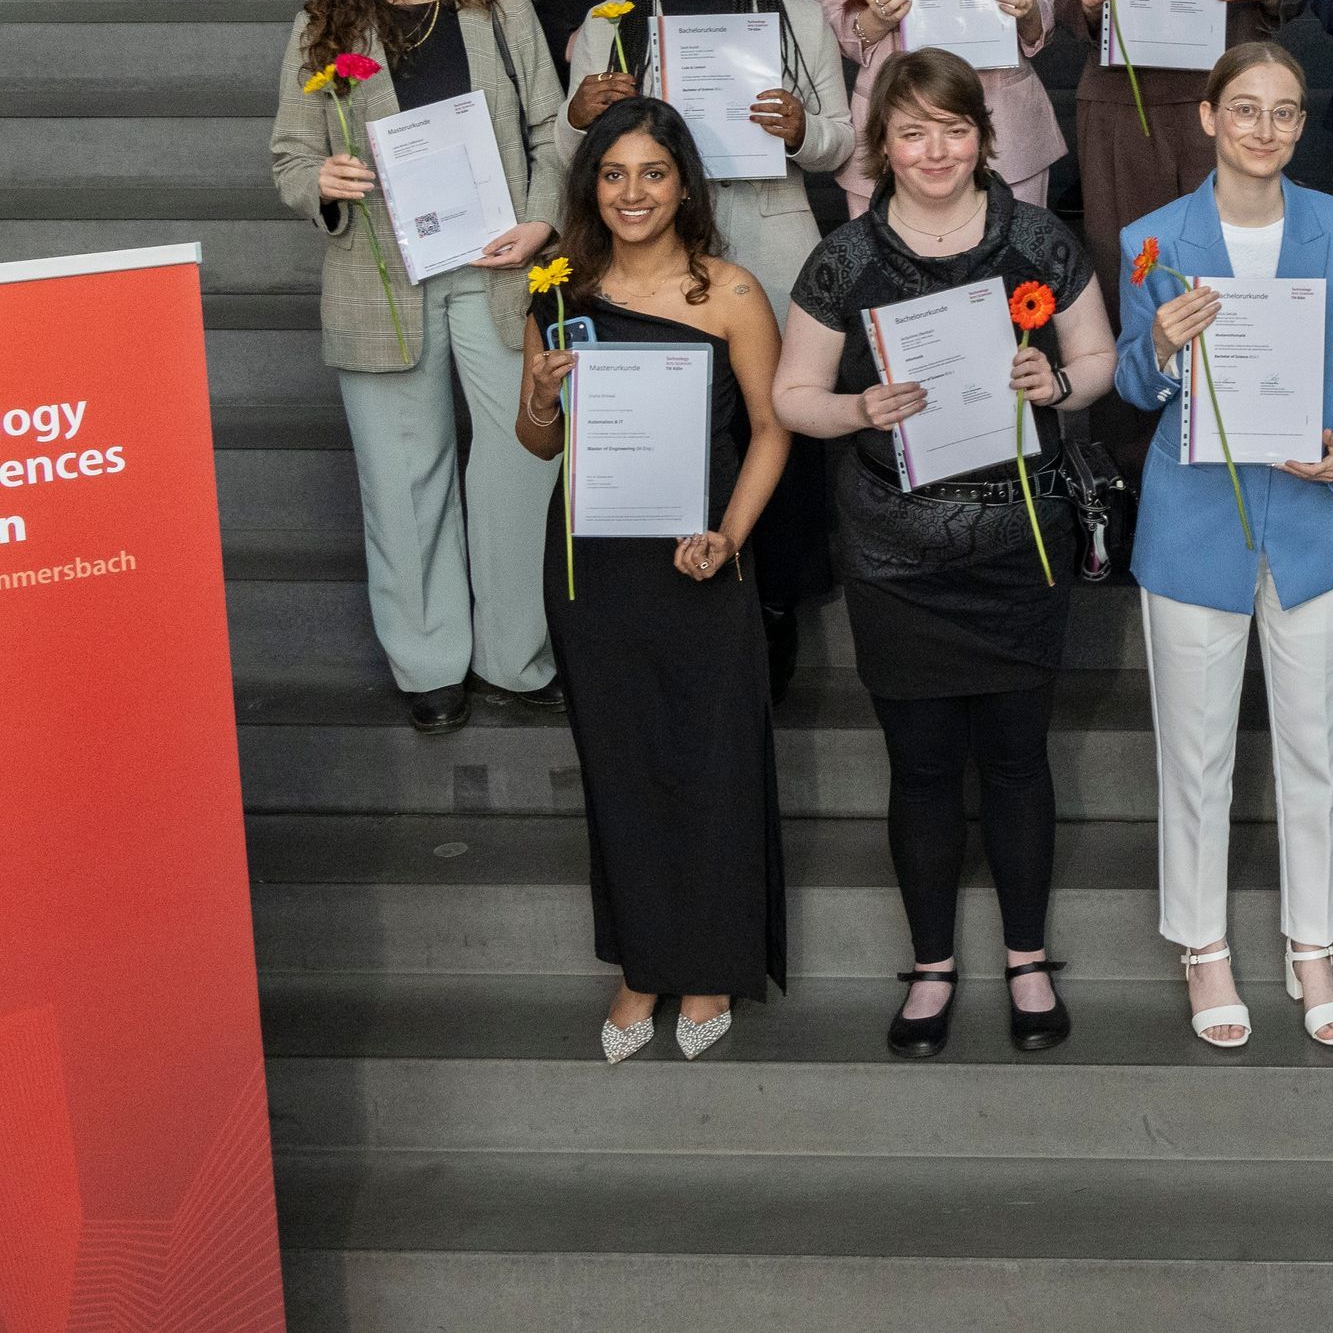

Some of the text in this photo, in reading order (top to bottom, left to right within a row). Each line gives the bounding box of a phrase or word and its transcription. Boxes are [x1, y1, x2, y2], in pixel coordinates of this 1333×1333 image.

[679, 26, 728, 35] Bachelorurkunde
[387, 118, 431, 135] Masterurkunde
[895, 306, 949, 325] Bachelorurkunde
[589, 363, 641, 372] Masterurkunde
